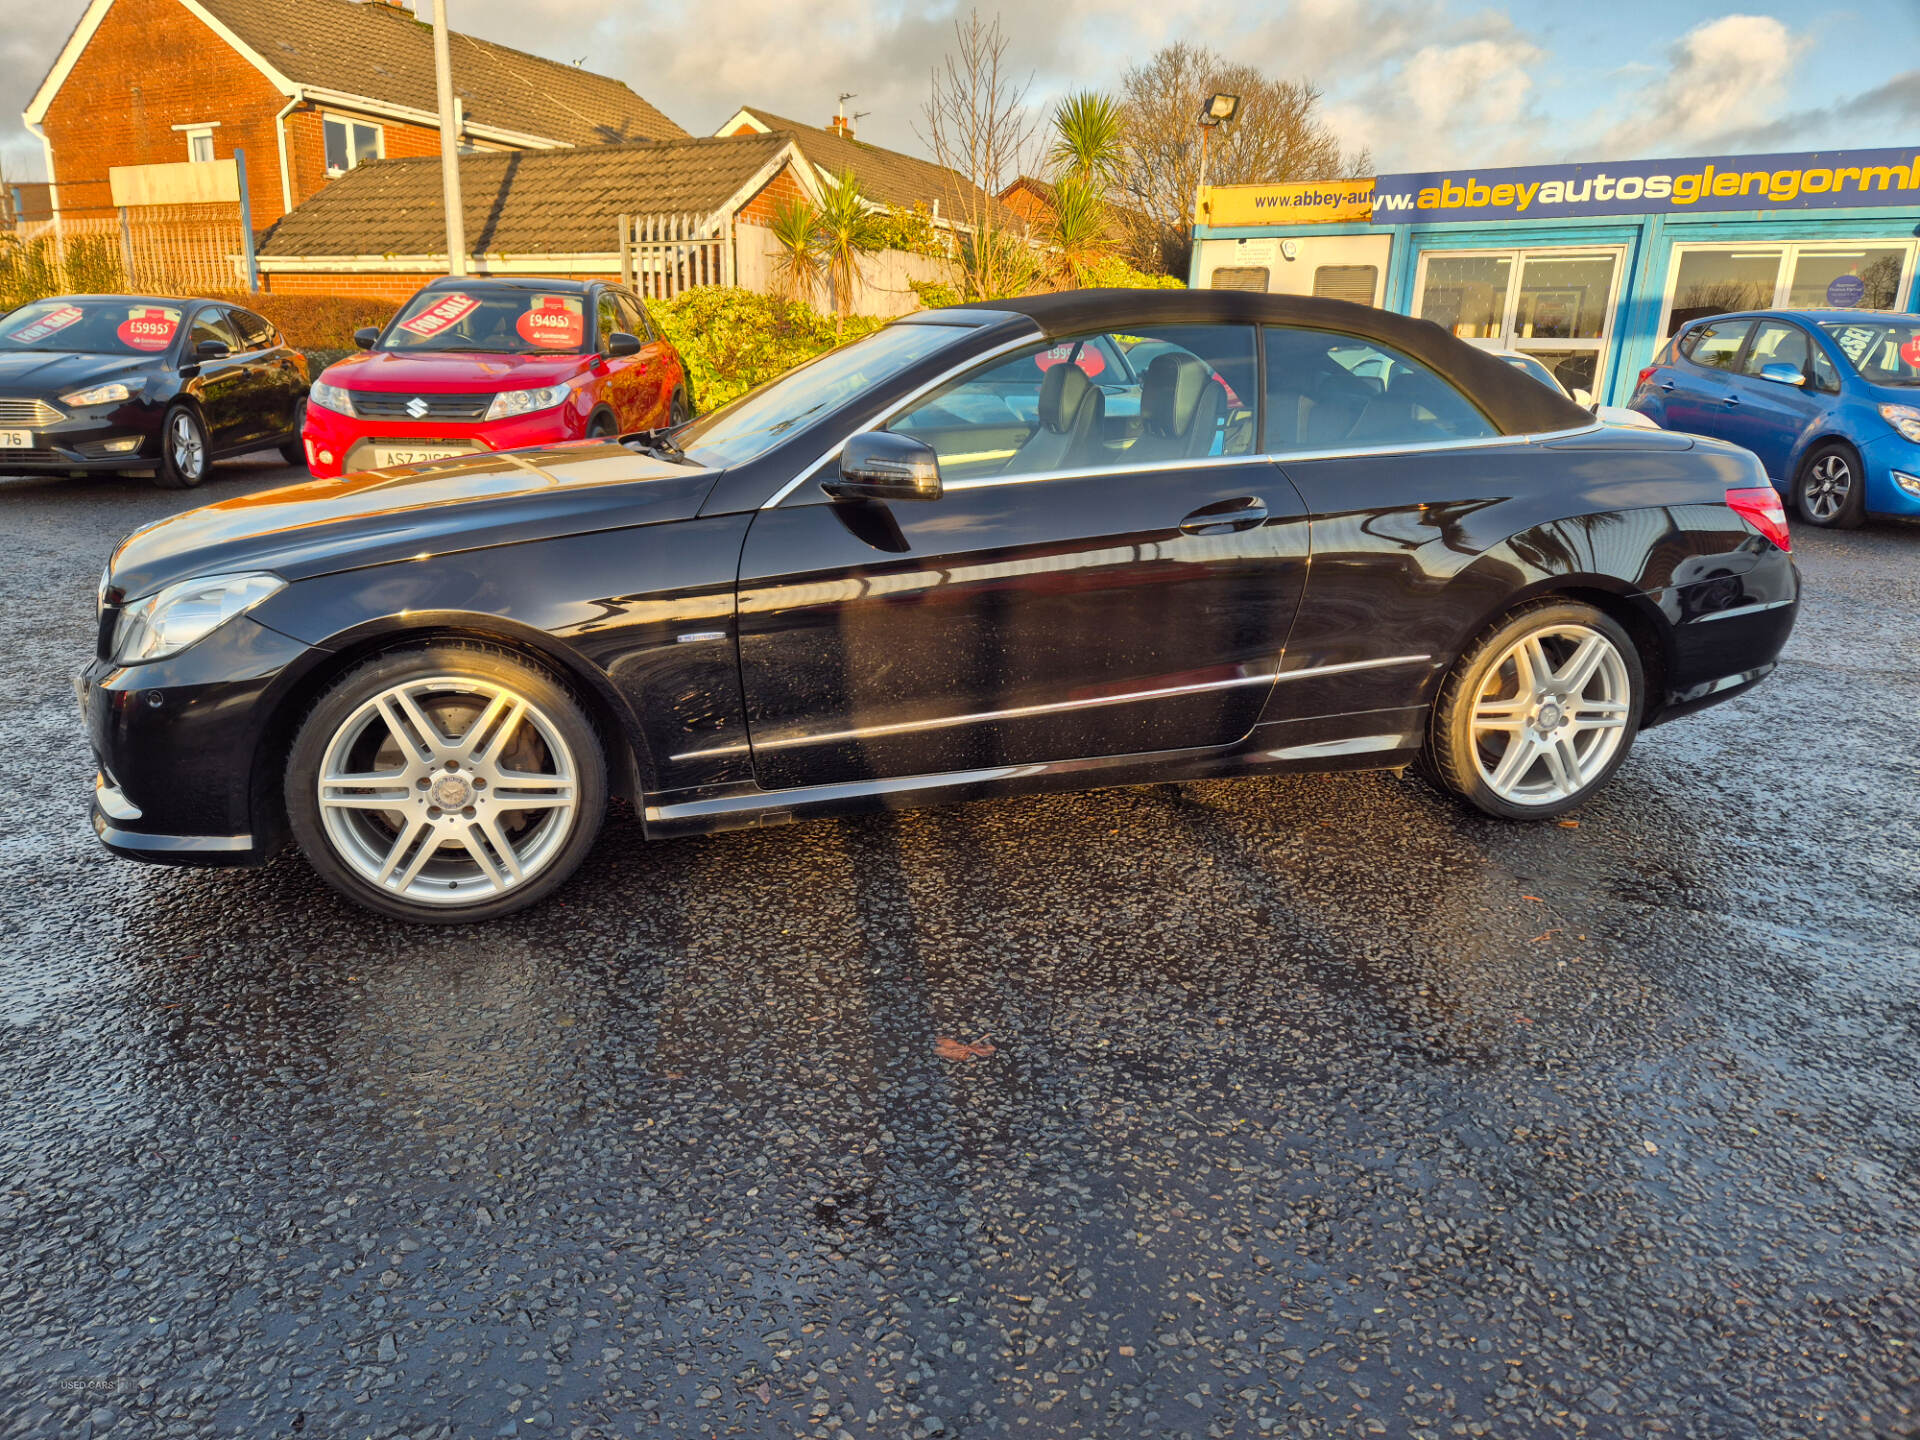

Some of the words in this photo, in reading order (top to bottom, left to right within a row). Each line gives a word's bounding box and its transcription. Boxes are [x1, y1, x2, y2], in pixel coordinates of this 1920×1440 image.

[17, 323, 50, 341] FOR
[48, 307, 80, 329] SALE
[408, 314, 442, 333] FOR
[439, 294, 473, 323] SALE
[387, 452, 414, 465] ASZ
